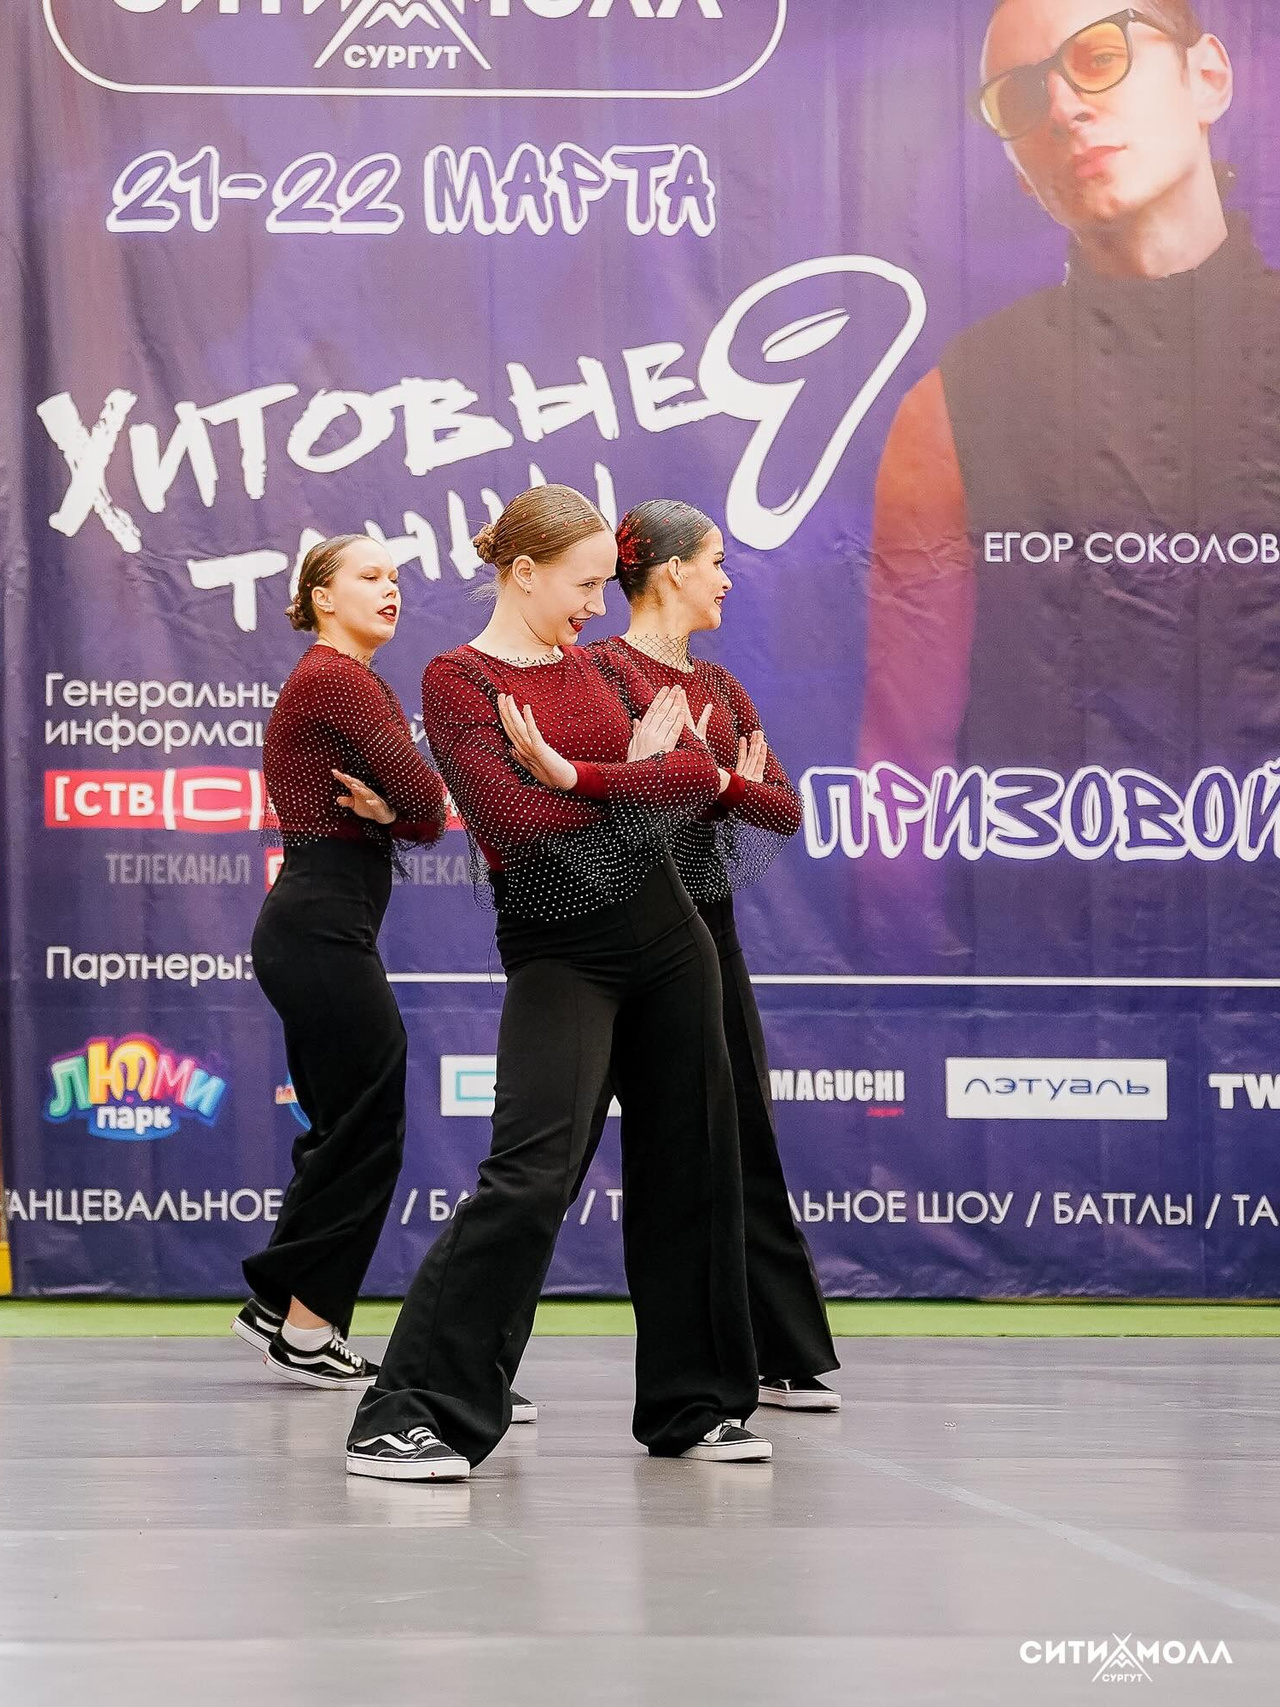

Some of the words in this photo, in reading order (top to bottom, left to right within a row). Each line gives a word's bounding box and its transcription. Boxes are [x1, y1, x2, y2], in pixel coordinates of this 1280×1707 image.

[343, 44, 462, 70] СУРГУТ
[106, 146, 405, 235] 21-22
[423, 142, 718, 237] МАРТА
[36, 340, 710, 554] ХИТОВЫЕ
[983, 531, 1074, 563] ЕГОР
[1084, 531, 1280, 564] СОКОЛОВ
[105, 852, 252, 886] ТЕЛЕКАНАЛ
[45, 945, 253, 987] Партнеры:
[96, 1105, 172, 1135] парк
[917, 1190, 1014, 1225] ШОУ
[1052, 1192, 1193, 1226] БАТТЛЫ
[1231, 1194, 1279, 1227] ТА
